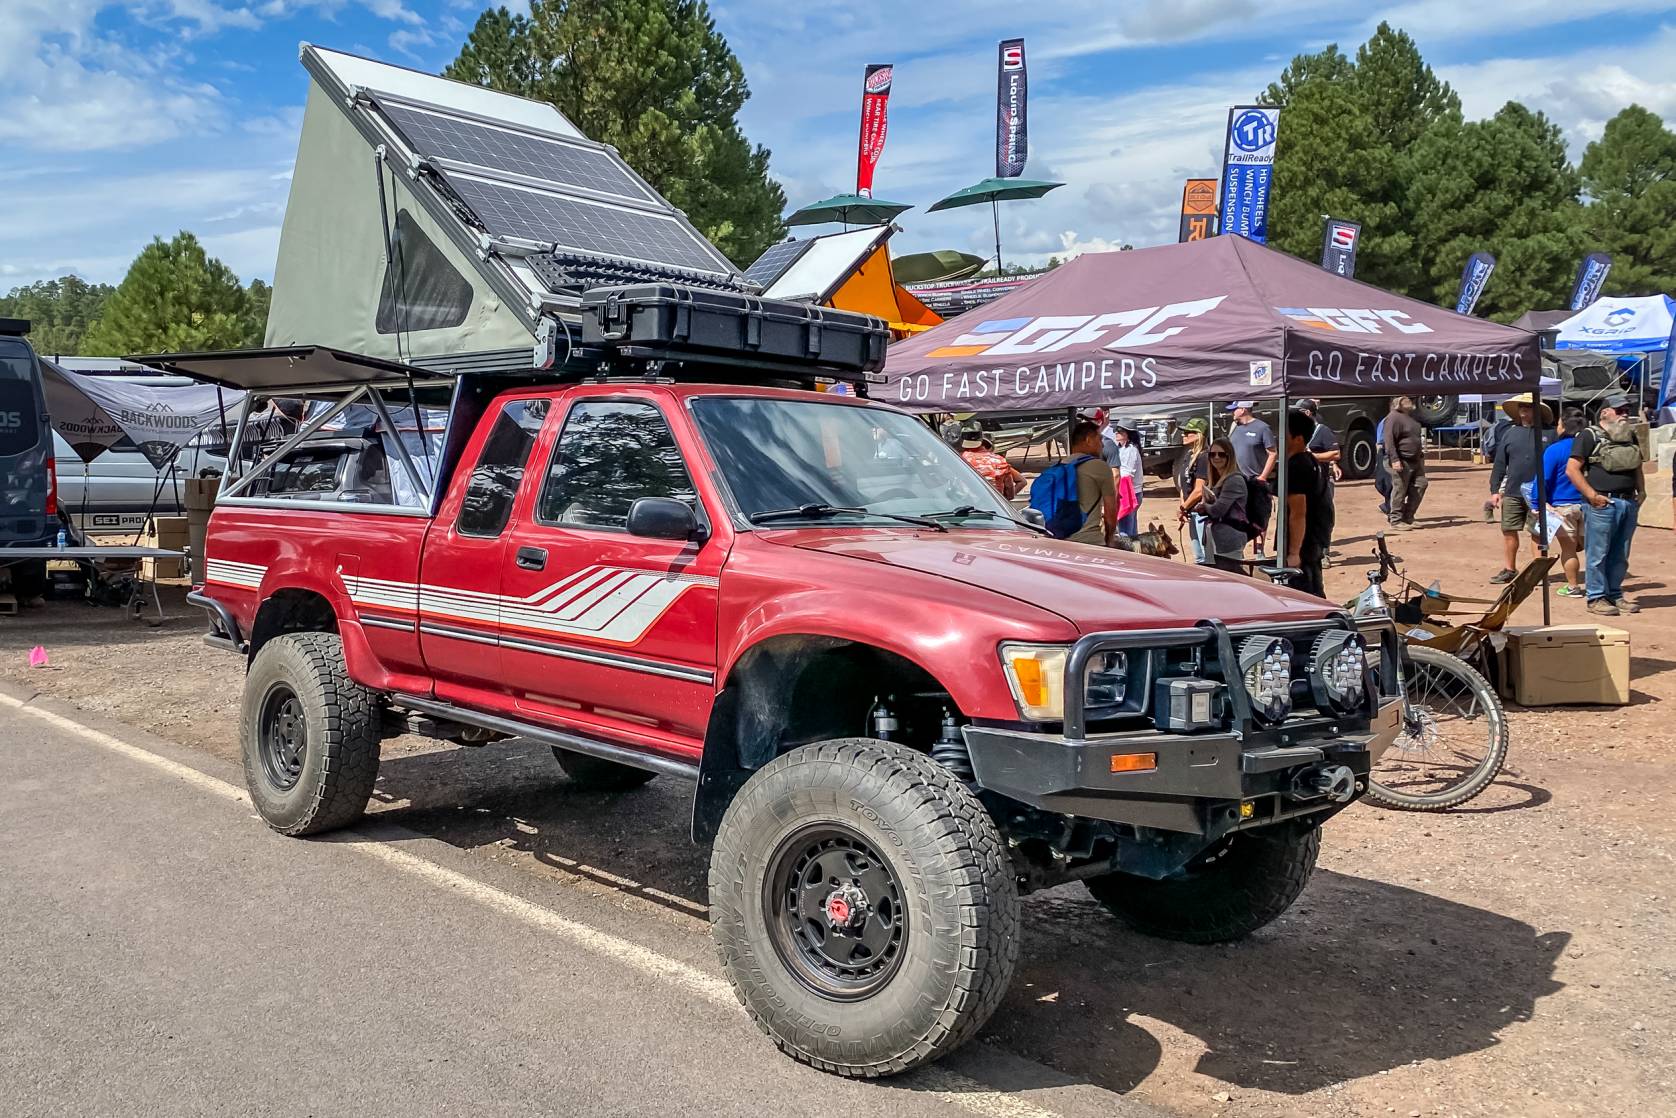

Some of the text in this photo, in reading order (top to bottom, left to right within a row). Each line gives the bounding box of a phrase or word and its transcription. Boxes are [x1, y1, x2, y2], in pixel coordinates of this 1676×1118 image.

[1229, 153, 1274, 164] TrailReady
[1226, 168, 1239, 232] SUSPENSION
[1244, 168, 1254, 205] WINCH
[1254, 168, 1268, 228] HD WHEELS
[979, 295, 1228, 356] GFC
[1306, 307, 1435, 334] GFC
[899, 357, 1158, 402] GO FAST CAMPERS
[1308, 350, 1524, 383] GO FAST CAMPERS
[121, 409, 200, 429] BACKWOODS
[850, 799, 904, 847] TOYO
[784, 1007, 842, 1037] OPEN
